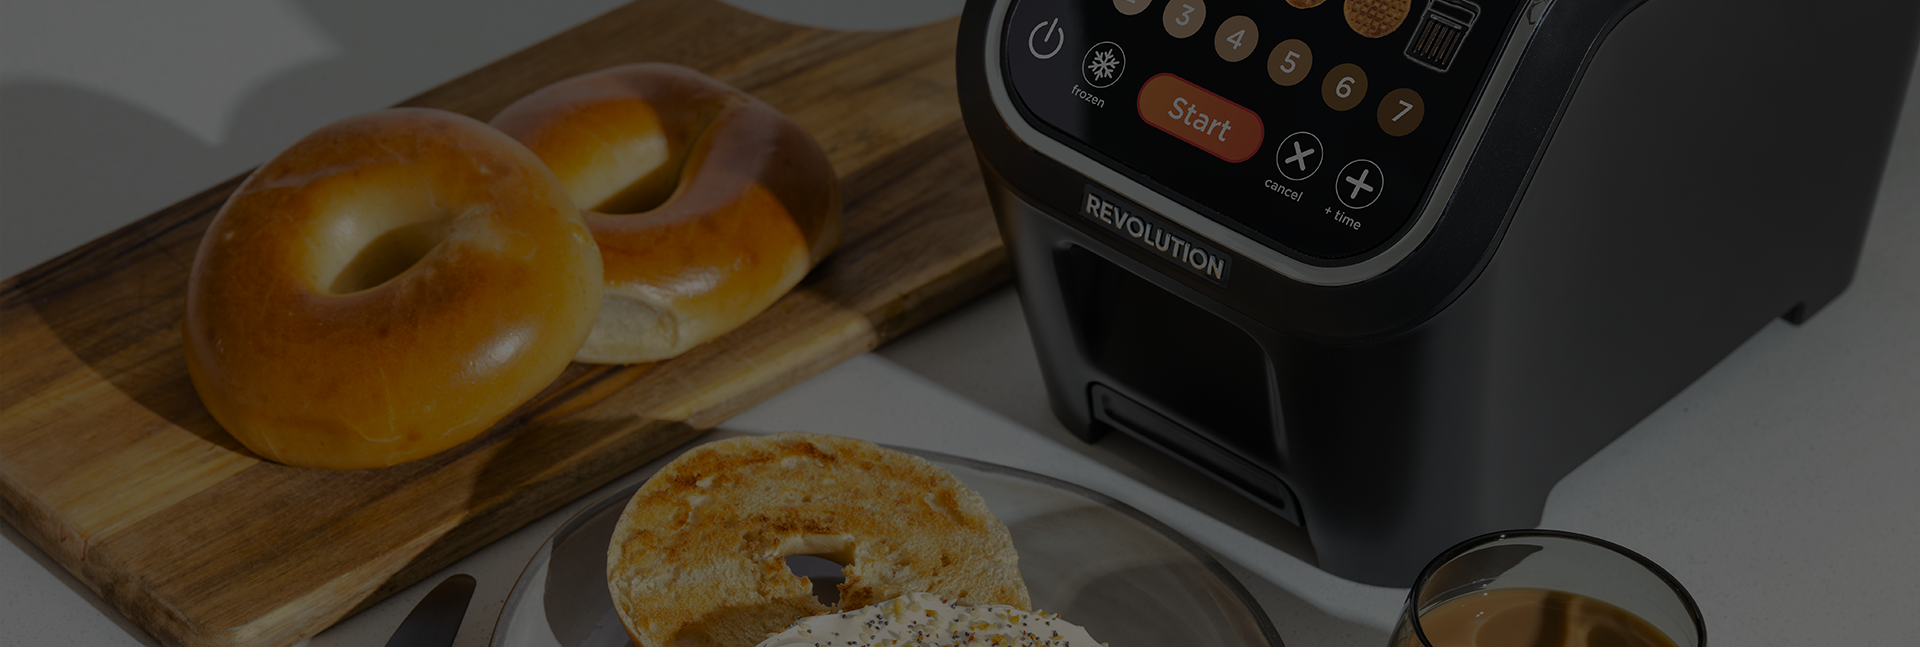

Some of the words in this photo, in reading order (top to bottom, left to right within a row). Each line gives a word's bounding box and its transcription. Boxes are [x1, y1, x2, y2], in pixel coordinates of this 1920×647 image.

[1175, 4, 1196, 26] 3
[1226, 29, 1246, 51] 4
[1280, 50, 1301, 74] 5
[1335, 76, 1356, 99] 6
[1391, 99, 1414, 122] 7
[1070, 83, 1107, 109] frozen
[1167, 96, 1233, 143] Start
[1264, 177, 1304, 203] cancel
[1086, 193, 1226, 280] REVOLUTION
[1334, 210, 1362, 231] time
